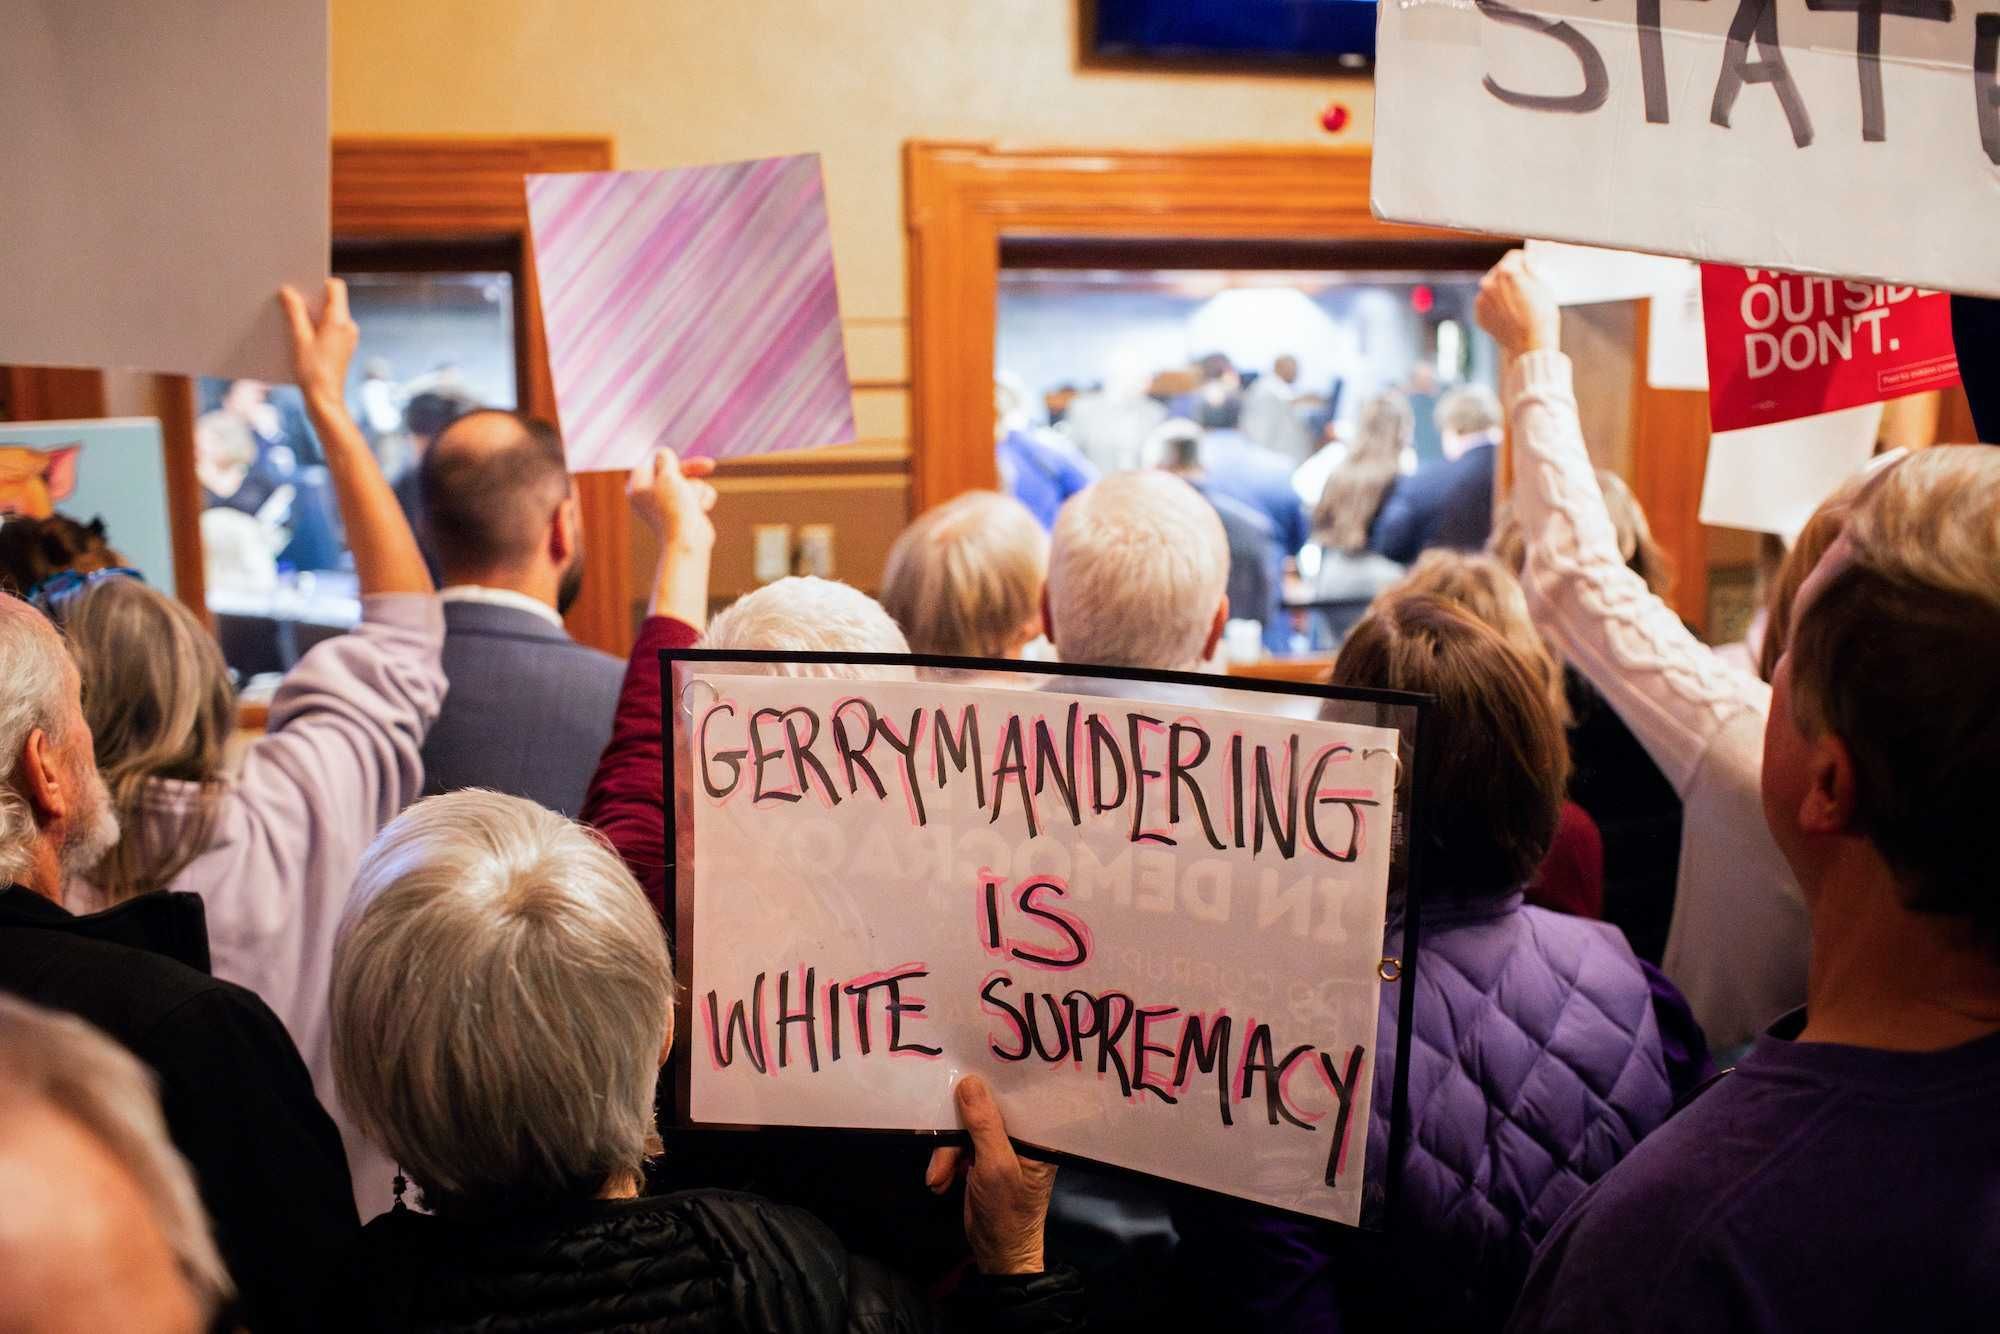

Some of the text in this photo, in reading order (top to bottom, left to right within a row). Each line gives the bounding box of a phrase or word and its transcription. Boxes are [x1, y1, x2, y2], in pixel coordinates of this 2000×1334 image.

[1741, 276, 1945, 330] OUTSID
[1744, 308, 1900, 379] DON'T.
[697, 698, 1380, 863] GERRYMANDERING
[979, 868, 1094, 971] IS
[701, 962, 1366, 1188] WHITE SUPREMACY
